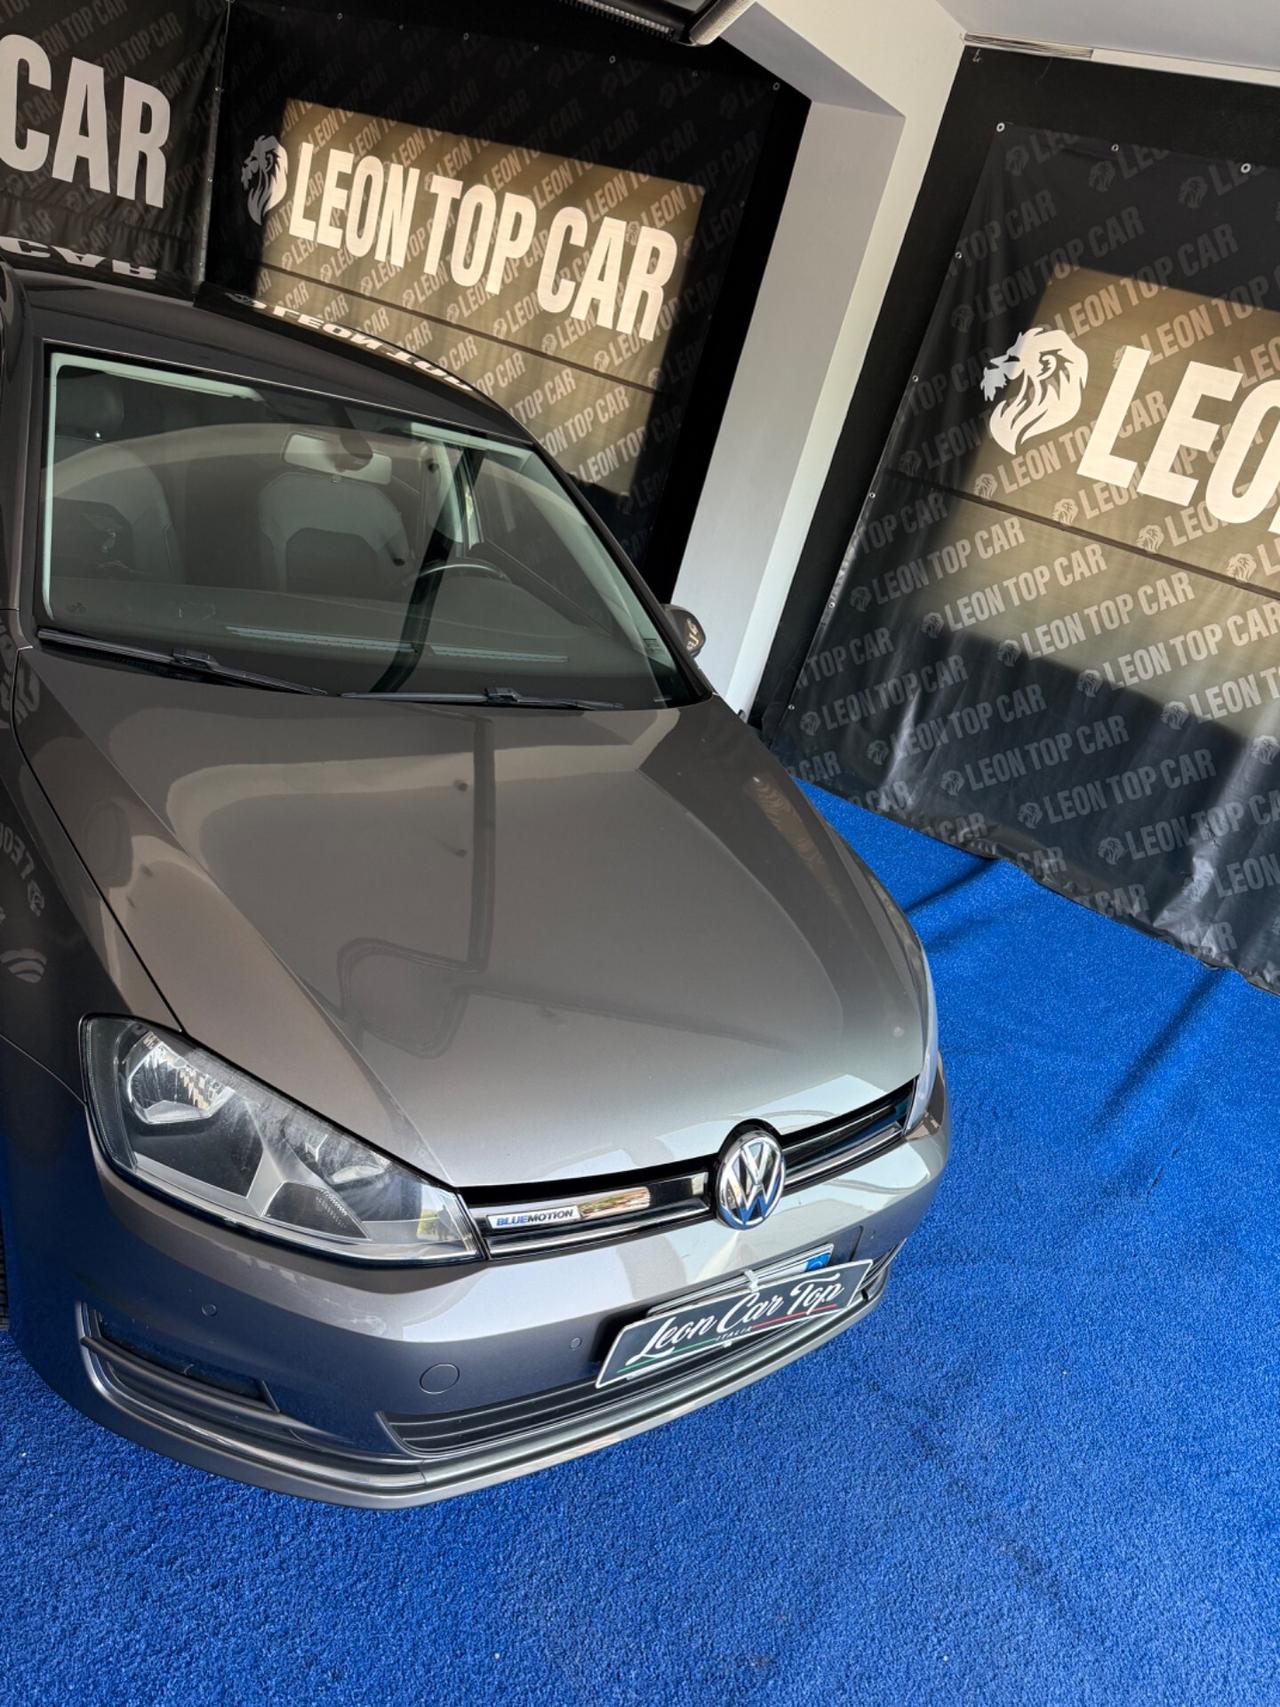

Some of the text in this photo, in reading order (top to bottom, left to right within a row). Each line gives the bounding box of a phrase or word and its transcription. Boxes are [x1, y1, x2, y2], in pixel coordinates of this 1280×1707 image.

[61, 6, 94, 43] TOP
[120, 28, 152, 66] TOP
[149, 11, 184, 48] CAR
[0, 33, 172, 209] CAR
[533, 160, 576, 211] LEON
[586, 172, 630, 224] LEON
[640, 185, 688, 231] LEON
[289, 142, 678, 342] LEON TOP CAR
[1005, 189, 1057, 240] CAR
[414, 259, 450, 304] LEON
[975, 264, 1039, 323] LEON
[1033, 237, 1085, 287] TOP
[1087, 205, 1145, 258] CAR
[1119, 255, 1175, 308] TOP
[1177, 223, 1240, 277] CAR
[283, 279, 311, 312] CAR
[323, 293, 350, 323] CAR
[362, 306, 391, 338] CAR
[1139, 306, 1216, 366] LEON
[1210, 274, 1271, 330] TOP
[404, 320, 434, 353] CAR
[448, 335, 480, 372] CAR
[494, 350, 527, 389] CAR
[515, 366, 577, 424] TOP CAR
[562, 405, 596, 444] TOP
[593, 383, 631, 425] CAR
[578, 443, 621, 483] LEON
[920, 416, 982, 471] LEON
[996, 437, 1063, 496] LEON
[858, 492, 949, 555] TOP CAR
[1164, 500, 1229, 548] LEO
[871, 516, 1027, 606] LEON TOP CAR
[943, 543, 1109, 634] LEON TOP CAR
[1021, 571, 1197, 662] LEON TOP CAR
[807, 626, 896, 684] TOP CAR
[1102, 600, 1280, 691] LEON TOP CAR
[821, 654, 969, 732] LEON TOP CAR
[947, 701, 994, 740] TOP
[995, 684, 1049, 724] CAR
[1189, 673, 1263, 723] LEON
[964, 715, 1131, 792] LEON TOP CAR
[1043, 748, 1218, 825] LEON TOP CAR
[1124, 816, 1193, 861] LEON
[1190, 801, 1246, 843] TOP
[496, 1210, 575, 1227] BLUEMOTION
[624, 1272, 845, 1367] Leon Car Top
